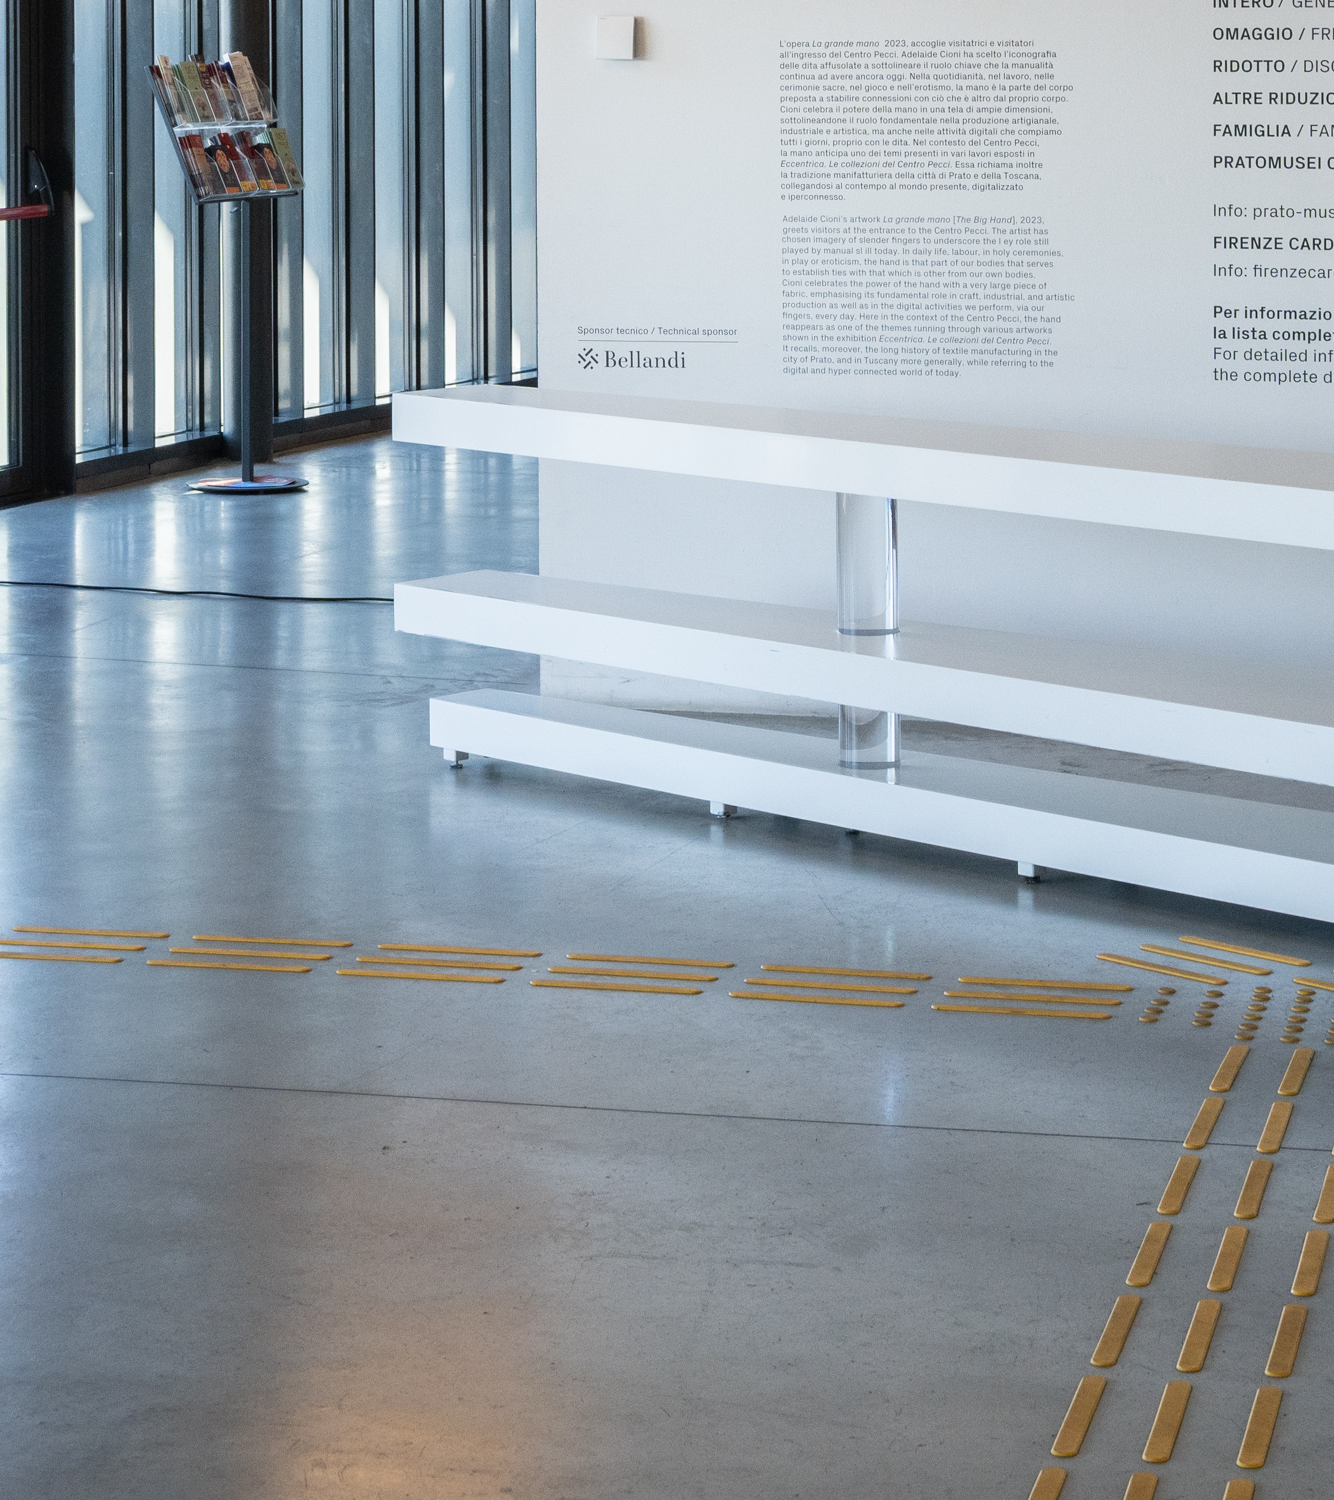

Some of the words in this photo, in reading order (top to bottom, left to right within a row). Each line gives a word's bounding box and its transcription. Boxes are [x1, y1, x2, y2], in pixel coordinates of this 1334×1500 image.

[1213, 27, 1292, 41] OMAGGIO
[1299, 27, 1305, 41] /
[780, 40, 810, 49] L'opera
[812, 40, 822, 48] La
[825, 39, 854, 50] grande
[885, 39, 908, 48] 2023,
[911, 39, 946, 49] accoglie
[949, 39, 987, 48] visitatrici
[990, 40, 994, 48] e
[997, 39, 1034, 48] visitatori
[1214, 59, 1285, 73] RIDOTTO
[1291, 59, 1297, 73] /
[1213, 91, 1262, 105] ALTRE
[1214, 123, 1291, 138] FAMIGLIA
[1297, 124, 1303, 138] /
[1214, 155, 1321, 170] PRATOMUSEI
[1214, 203, 1247, 218] Info:
[1214, 236, 1283, 250] FIRENZE
[1289, 237, 1333, 251] CARD
[1214, 263, 1247, 278] Info:
[1214, 305, 1239, 319] Per
[578, 325, 613, 336] Sponsor
[617, 326, 648, 335] tecnico
[651, 326, 655, 335] /
[658, 326, 699, 336] Technical
[702, 328, 737, 337] sponsor
[1214, 326, 1227, 340] la
[1233, 326, 1267, 341] lista
[605, 350, 685, 369] Bellandi
[1214, 346, 1238, 361] For
[1244, 347, 1307, 363] detailed
[1213, 367, 1238, 382] the
[1244, 369, 1317, 386] complete
